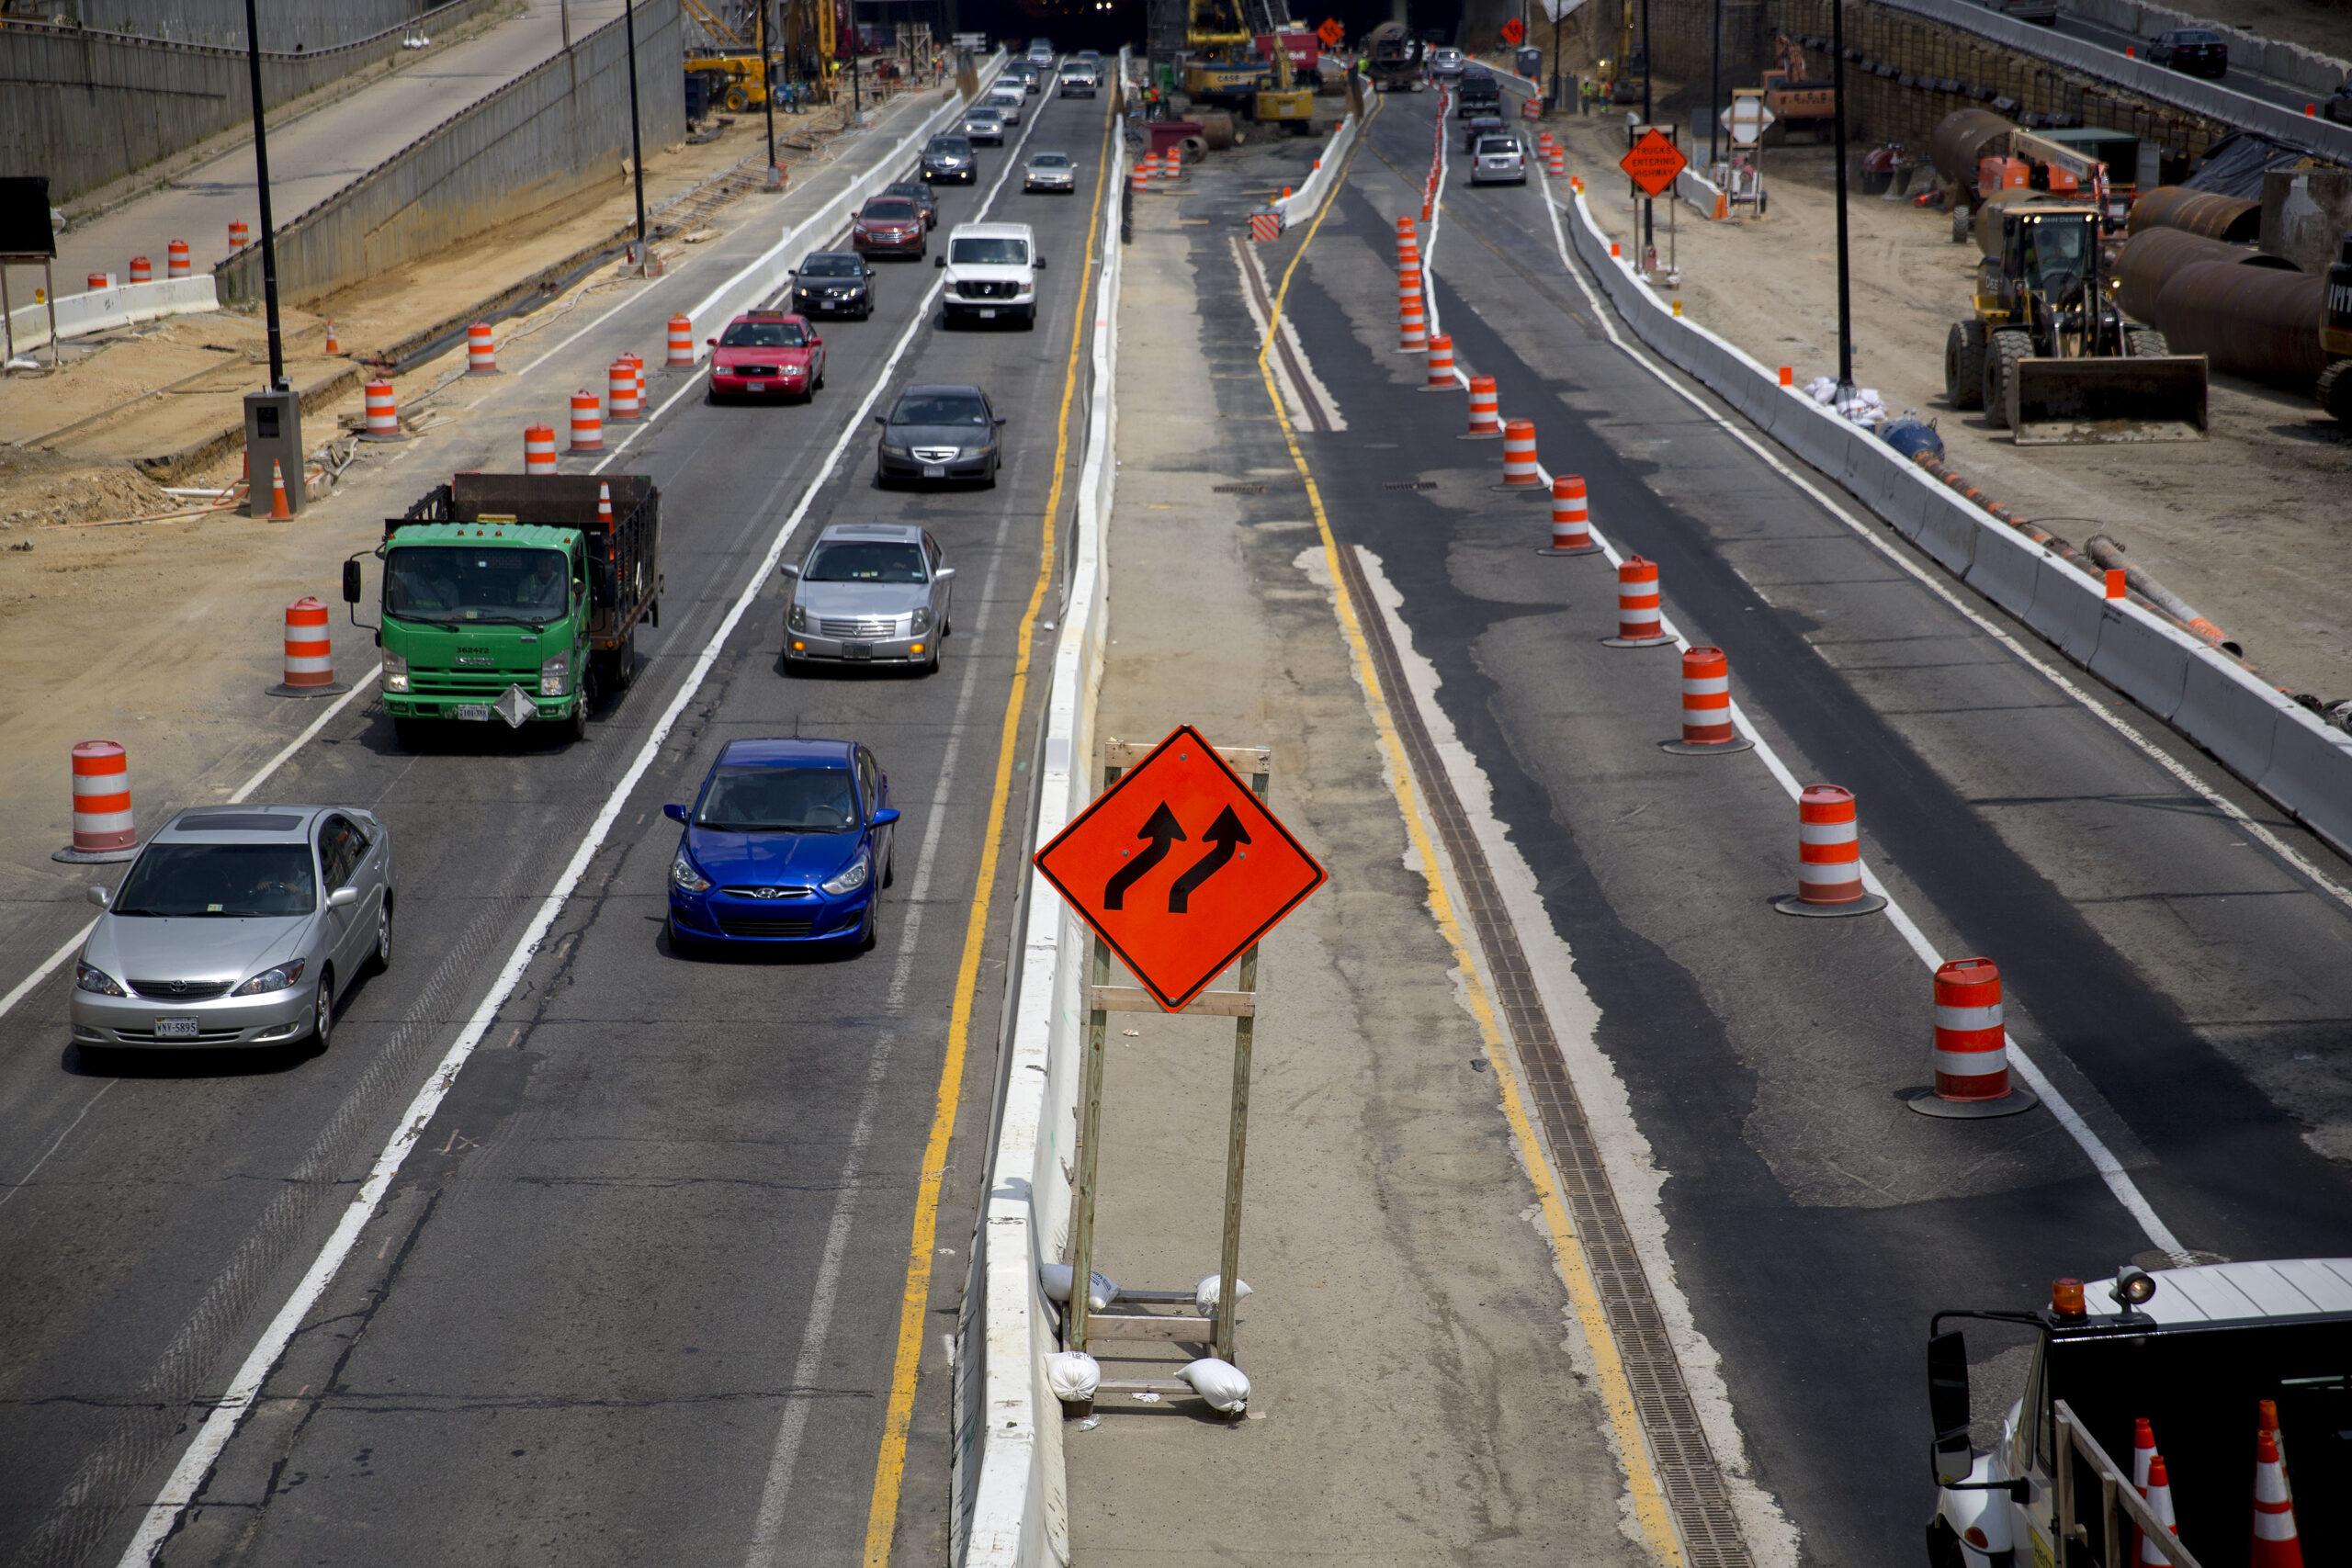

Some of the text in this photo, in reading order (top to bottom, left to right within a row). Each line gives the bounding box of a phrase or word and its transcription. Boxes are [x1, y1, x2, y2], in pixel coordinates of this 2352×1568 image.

[1636, 146, 1673, 155] TRUCKS
[1632, 157, 1676, 167] ENTERING
[1634, 168, 1675, 177] HIGHWAY
[457, 647, 490, 655] 362472
[455, 656, 494, 667] ISUZU
